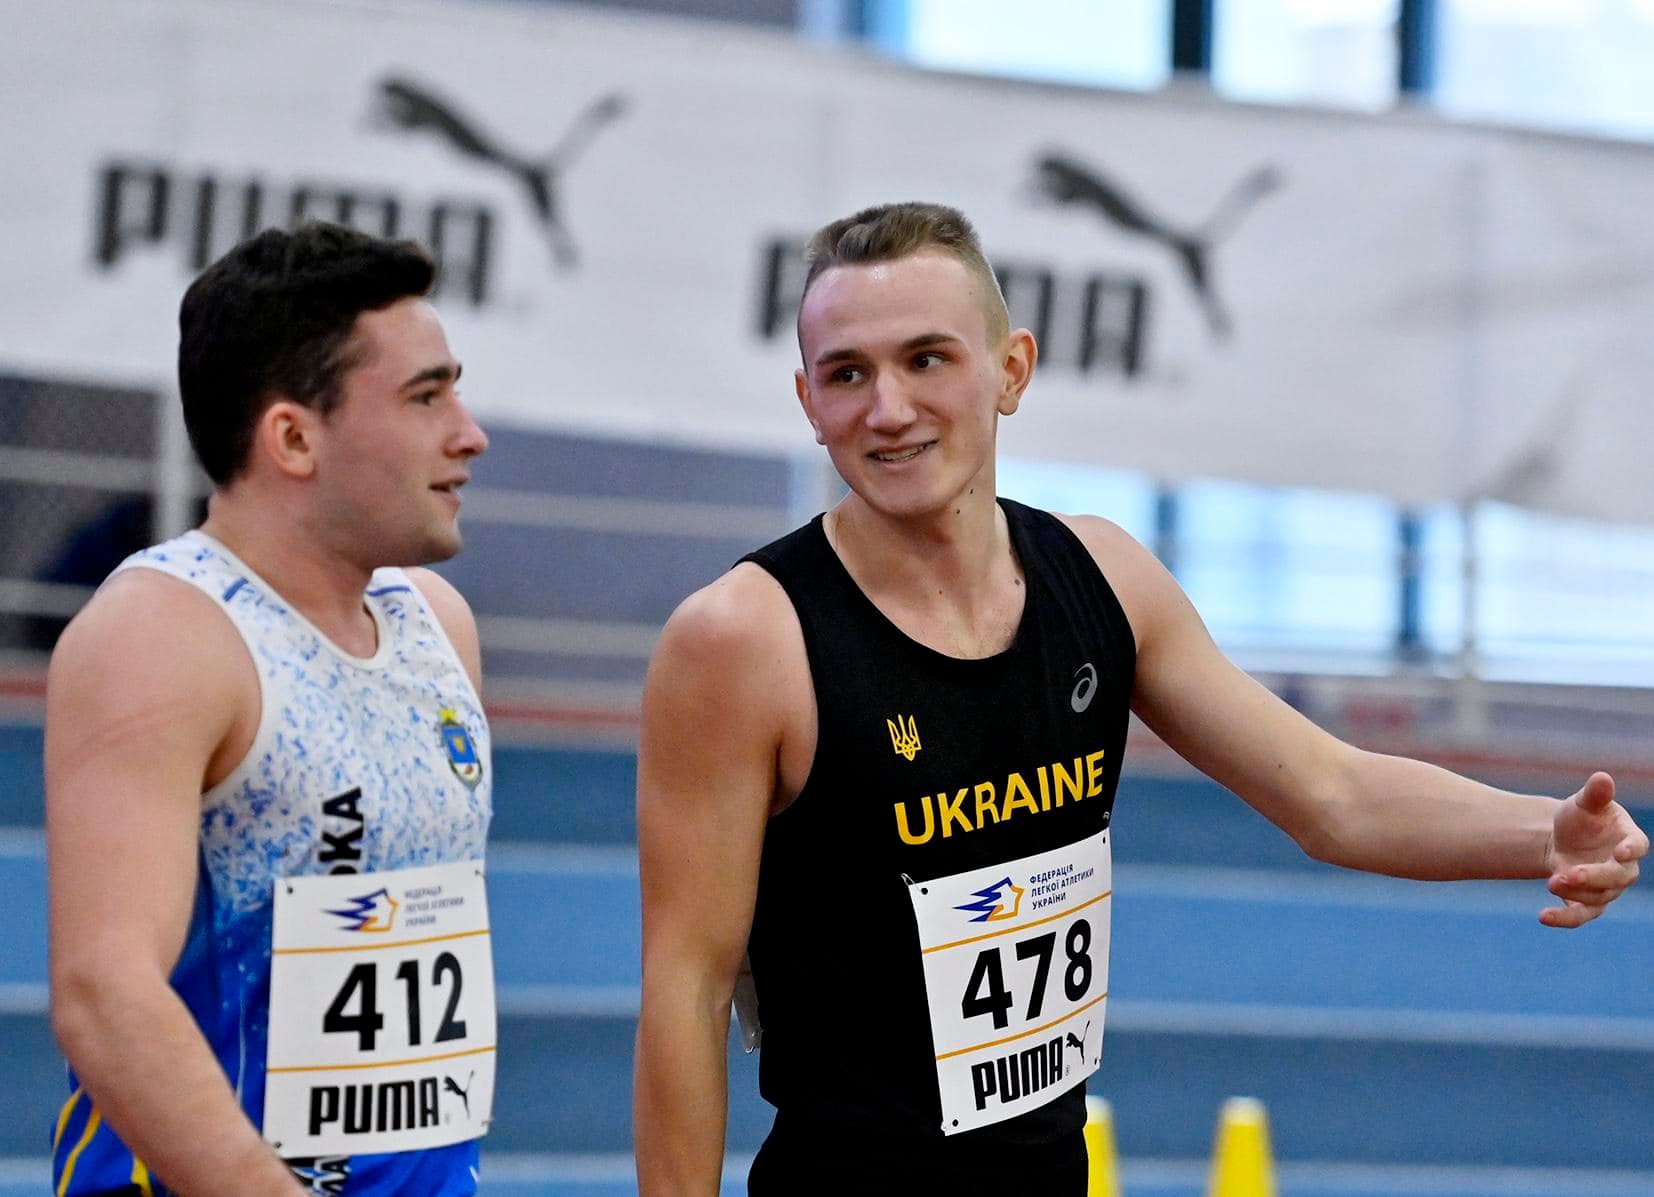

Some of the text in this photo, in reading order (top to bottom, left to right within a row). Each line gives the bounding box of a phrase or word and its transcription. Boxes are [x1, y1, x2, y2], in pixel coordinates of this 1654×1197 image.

[894, 749, 1105, 846] UKRAINE
[1029, 863, 1073, 884] ФЕДЕРАЦІЯ
[1032, 892, 1066, 910] УКРАЇНИ
[1061, 867, 1094, 888] АТЛЕТИКИ
[322, 951, 467, 1052] 412
[961, 918, 1093, 1030] 478
[308, 1076, 440, 1136] PUMA
[971, 1035, 1064, 1111] PUMA
